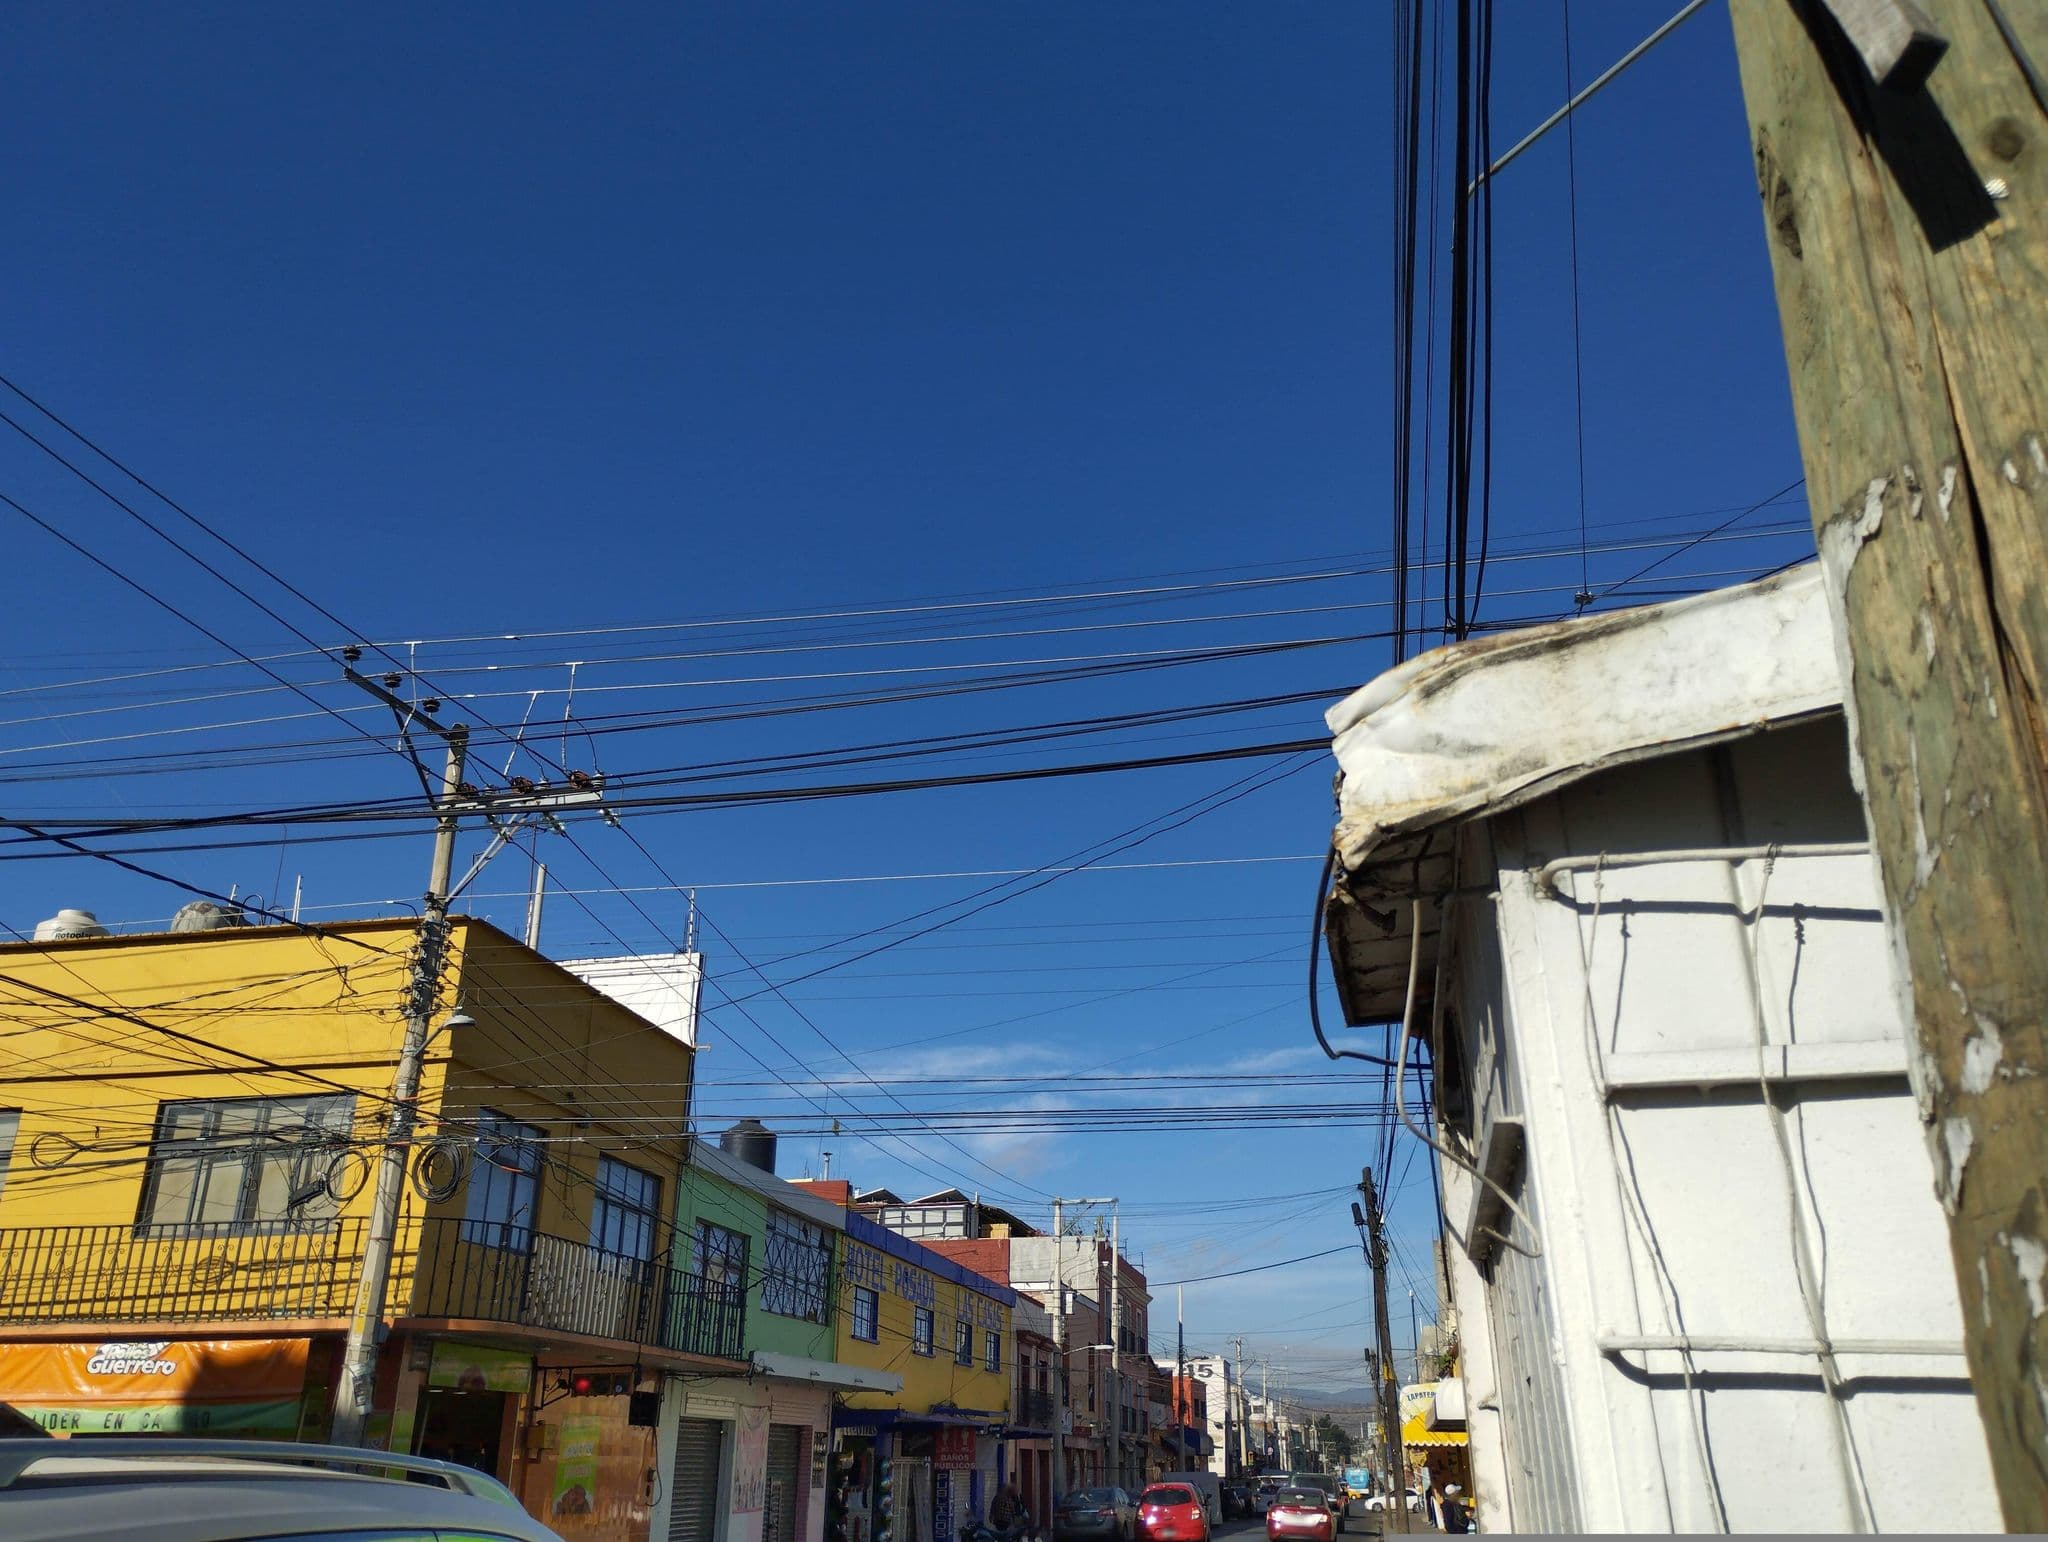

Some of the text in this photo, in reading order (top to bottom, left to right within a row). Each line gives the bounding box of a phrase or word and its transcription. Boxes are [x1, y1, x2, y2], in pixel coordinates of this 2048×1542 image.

[844, 1242, 887, 1292] HOTEL
[895, 1262, 936, 1311] POSADA
[87, 1355, 177, 1376] Guerrero
[104, 1412, 126, 1430] EN
